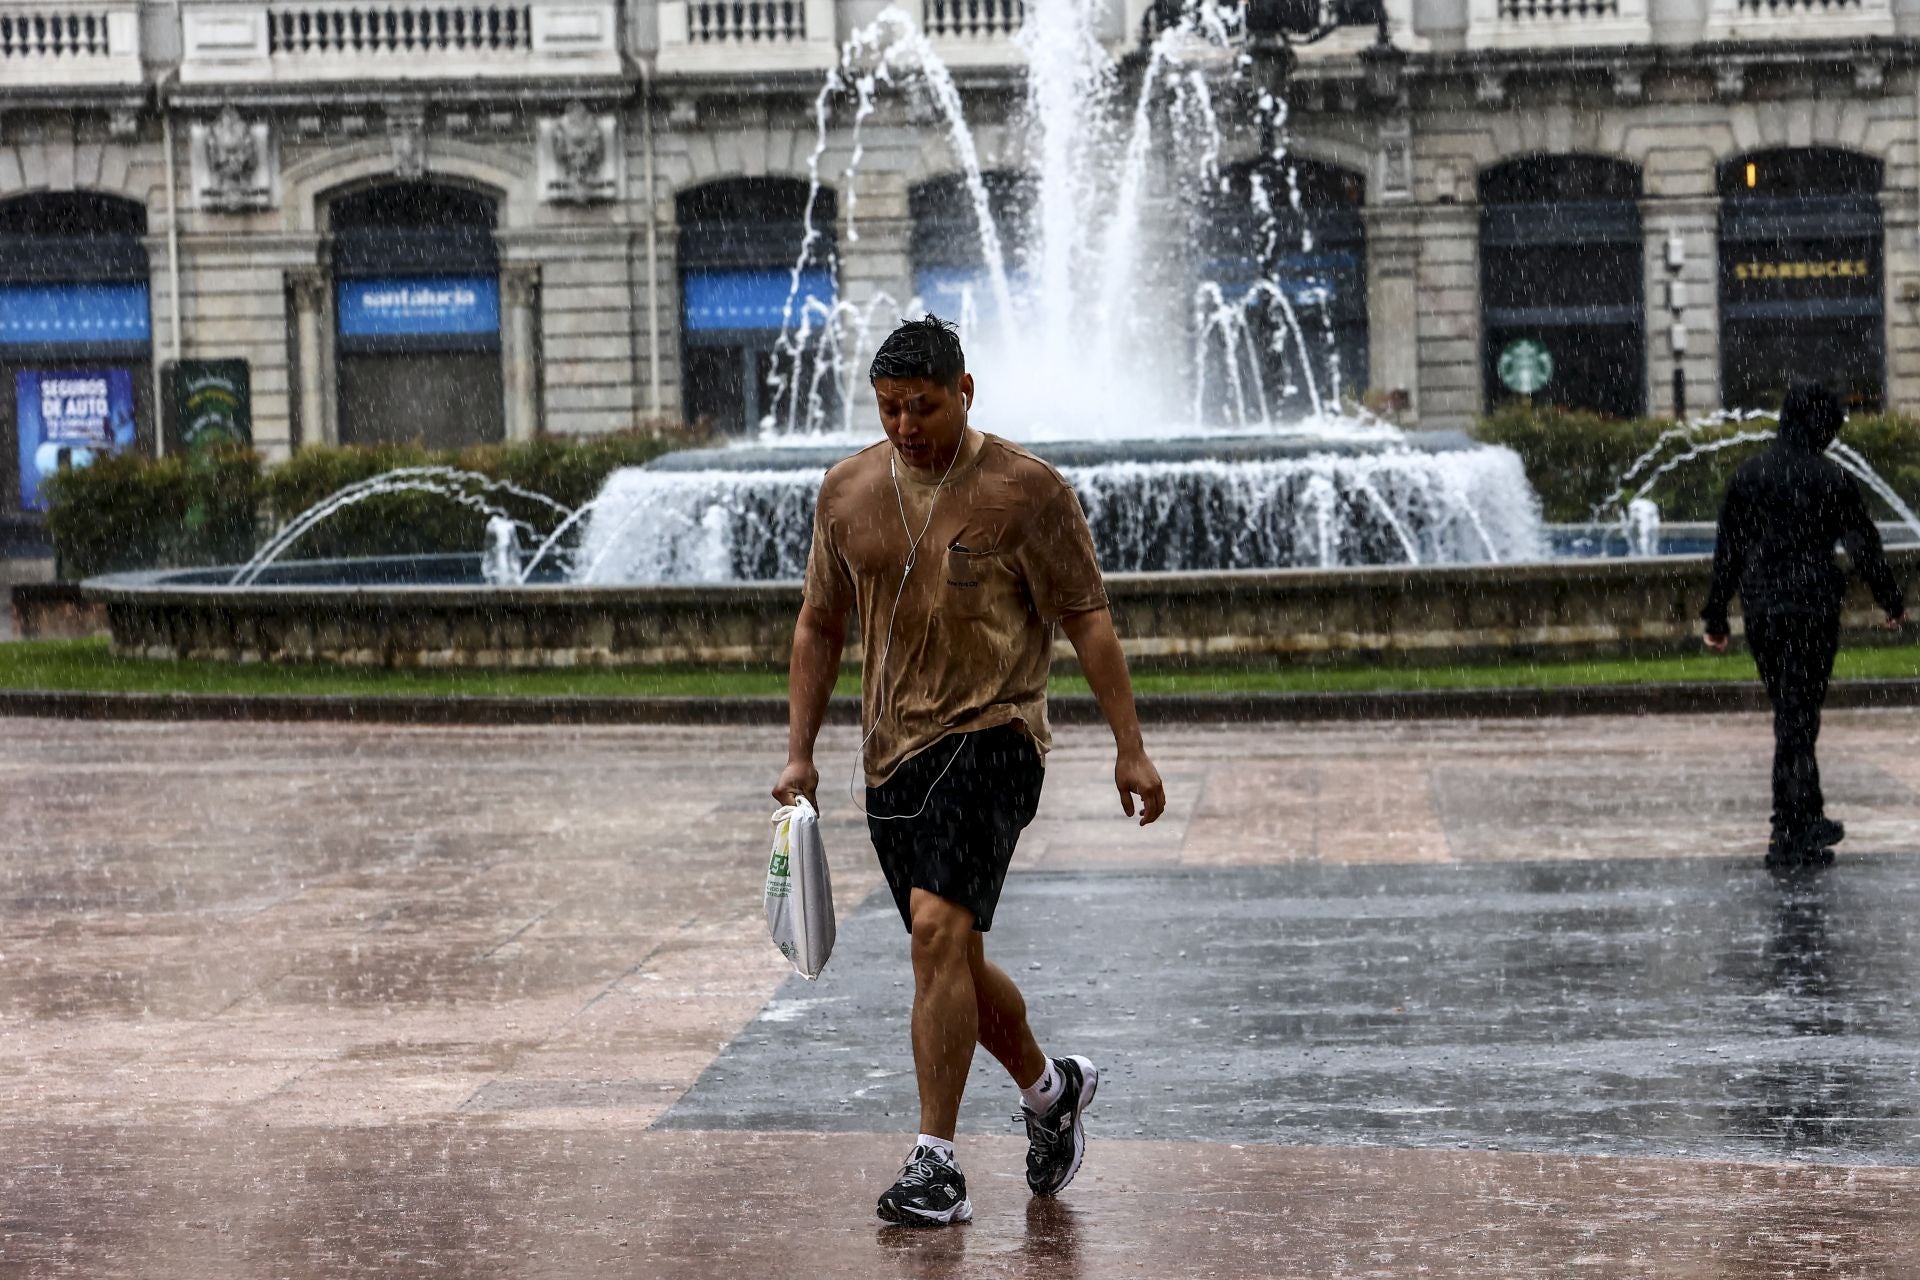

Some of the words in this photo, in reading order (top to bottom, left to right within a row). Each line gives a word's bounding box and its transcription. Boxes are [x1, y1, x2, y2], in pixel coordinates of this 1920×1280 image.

[1736, 261, 1867, 279] STARBUCKS
[41, 379, 107, 398] SEGUROS
[42, 398, 62, 417] DE
[65, 398, 108, 417] AUTO
